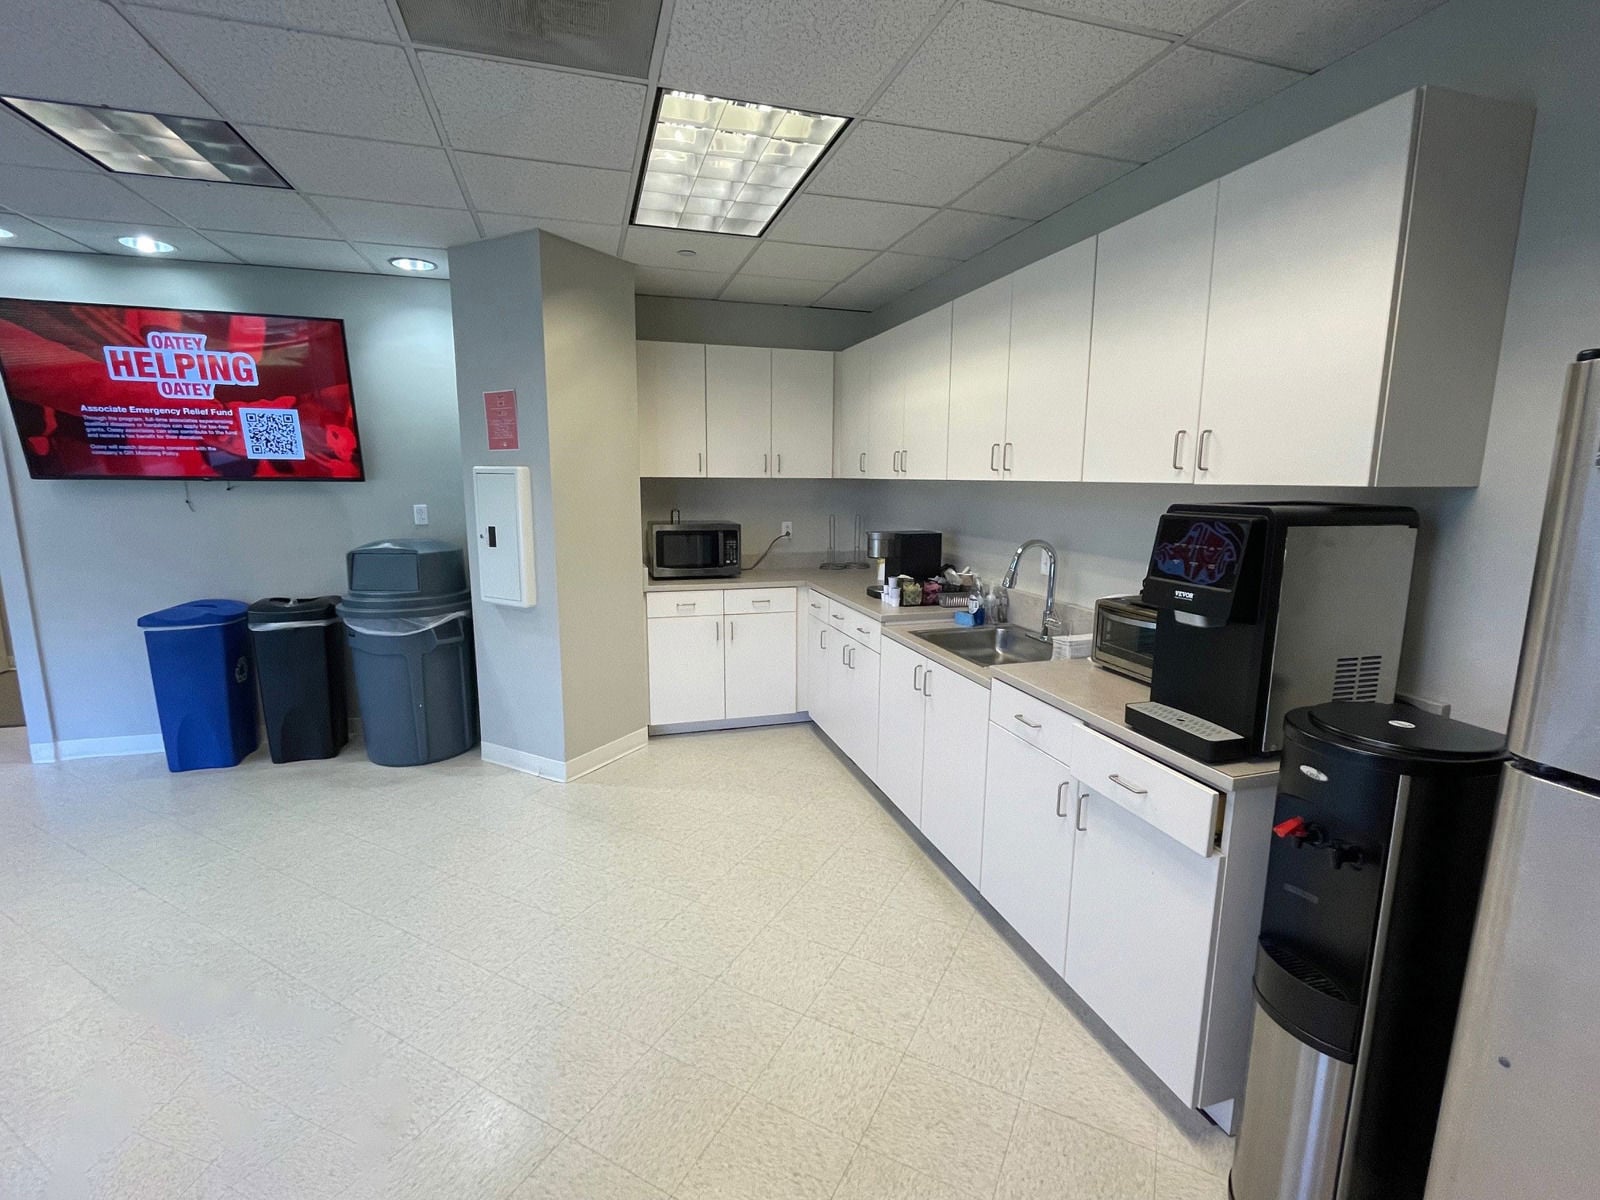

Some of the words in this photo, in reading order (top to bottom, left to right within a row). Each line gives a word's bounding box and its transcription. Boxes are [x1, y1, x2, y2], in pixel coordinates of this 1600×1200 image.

[151, 335, 203, 350] OATEY
[109, 350, 255, 383] HELPING
[161, 382, 211, 396] OATEY
[81, 404, 127, 413] Associate
[129, 405, 180, 416] Emergency
[183, 407, 209, 415] Relief
[211, 408, 233, 416] Fund
